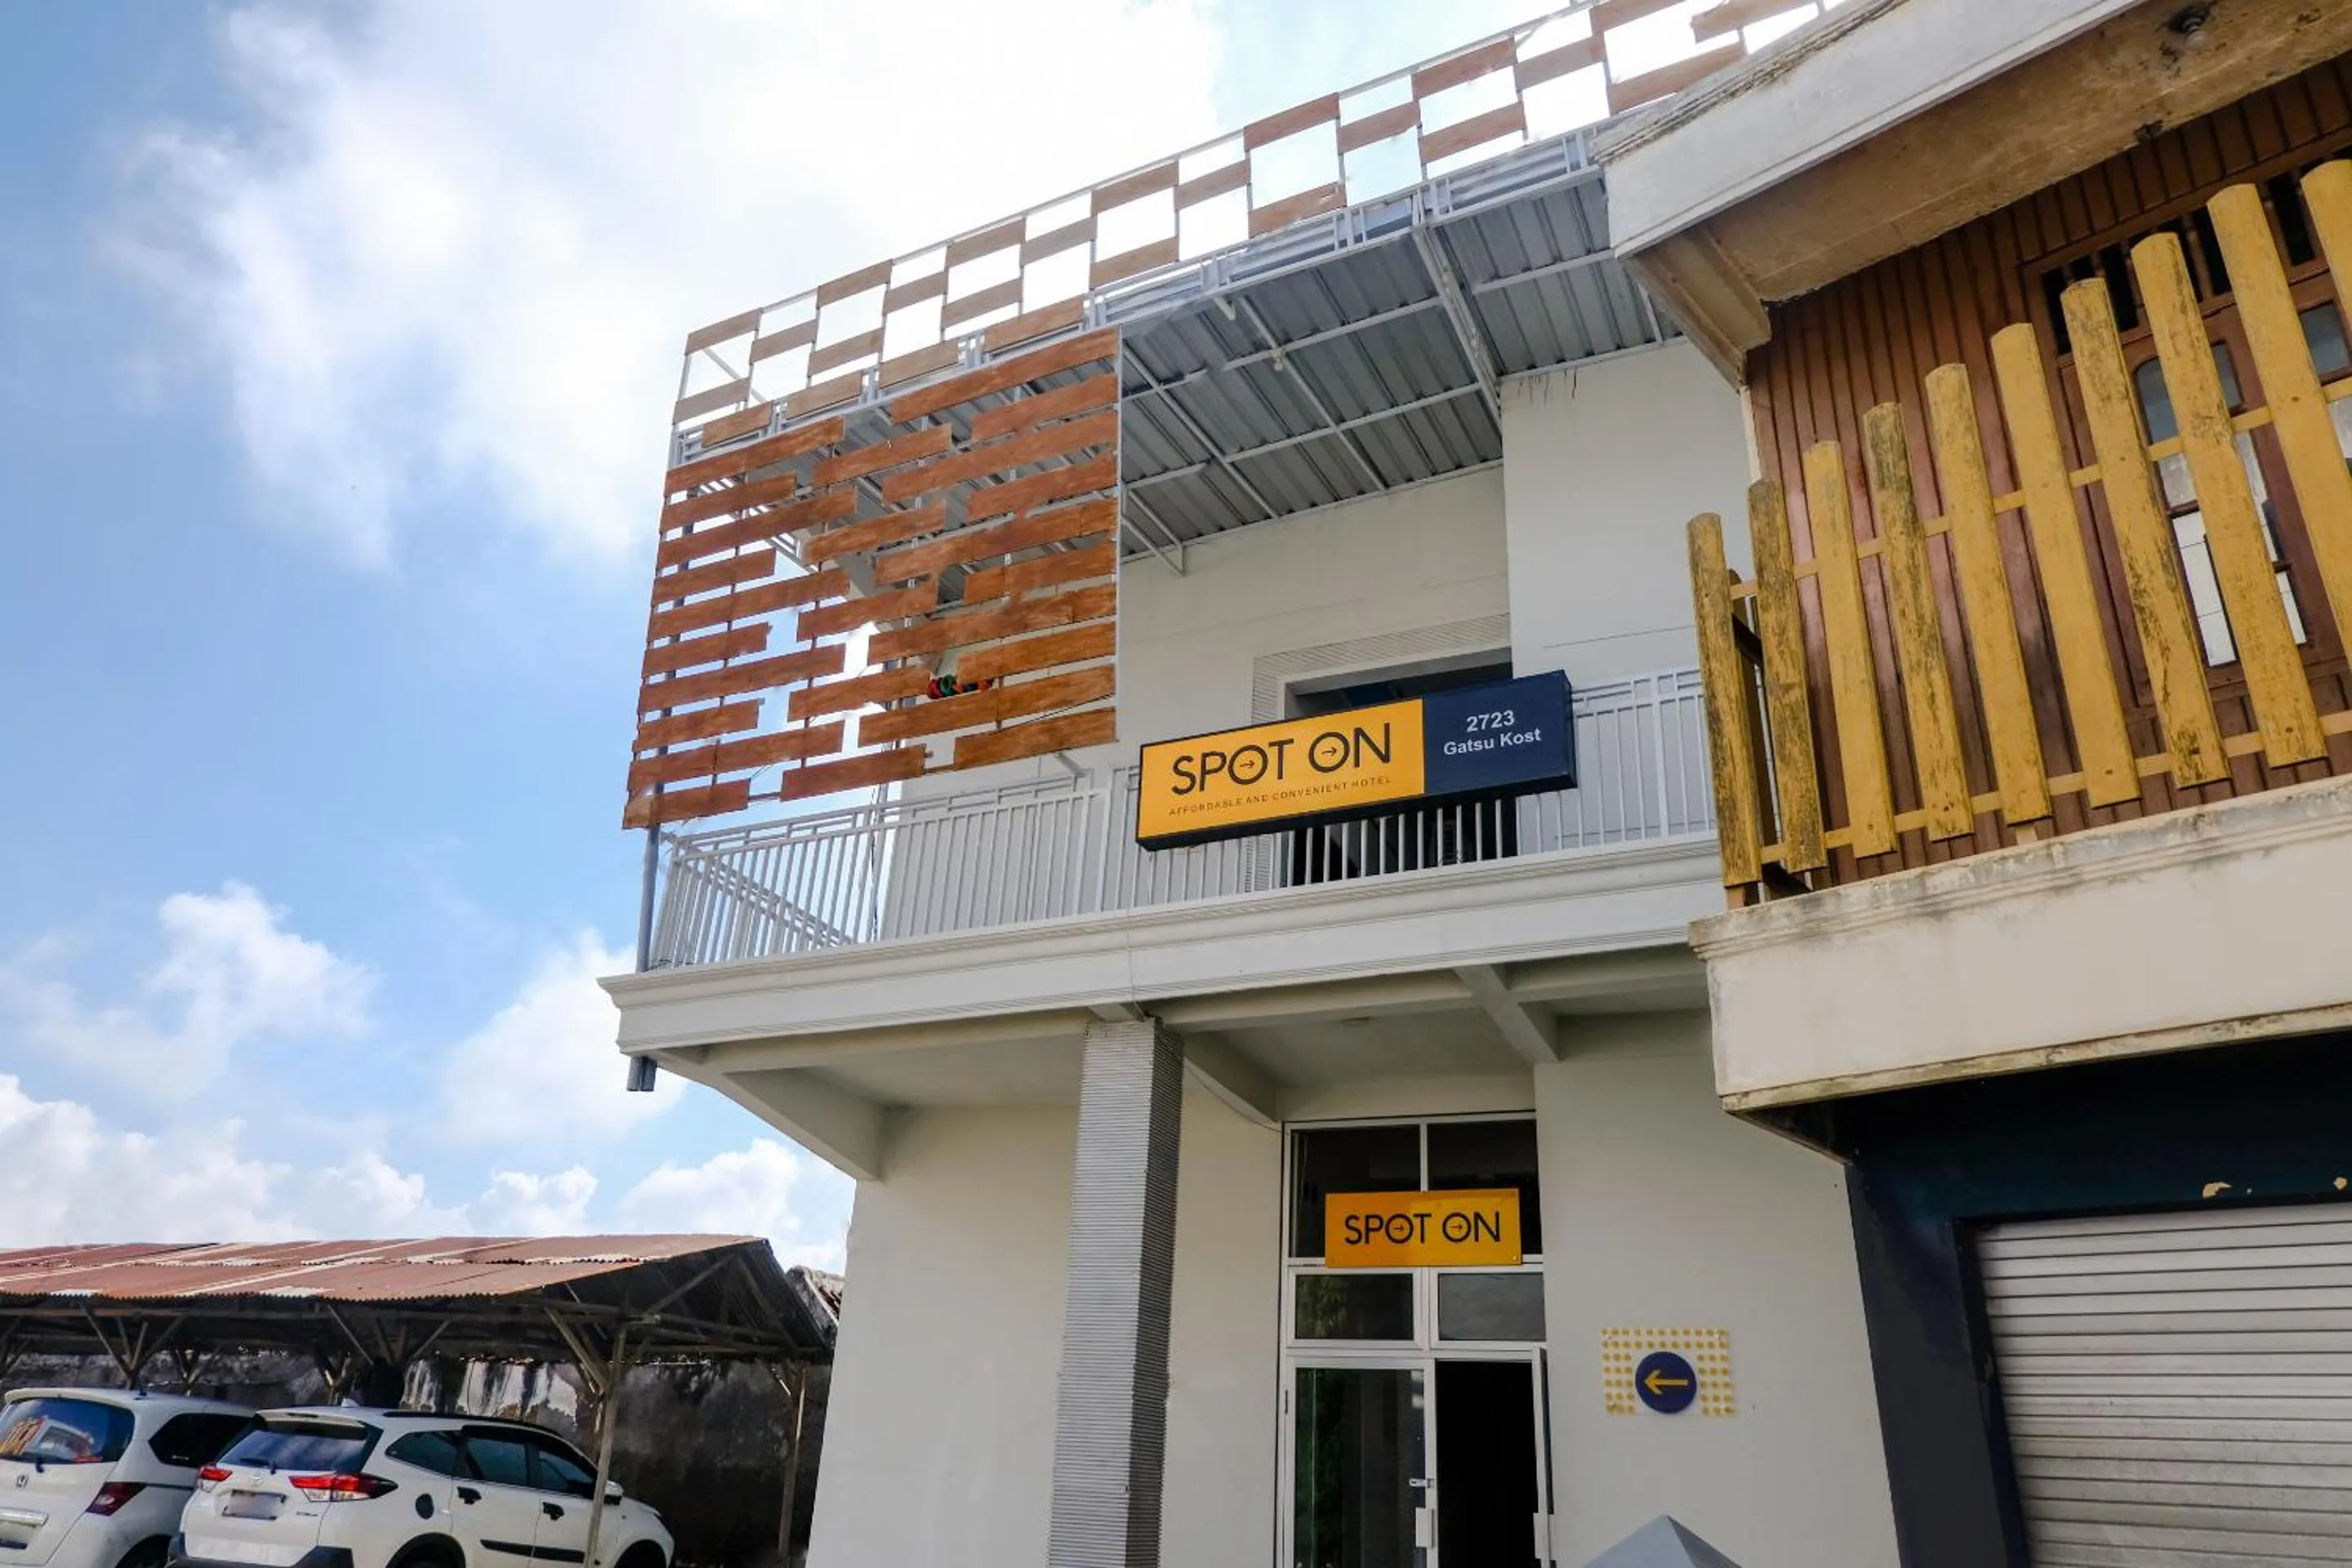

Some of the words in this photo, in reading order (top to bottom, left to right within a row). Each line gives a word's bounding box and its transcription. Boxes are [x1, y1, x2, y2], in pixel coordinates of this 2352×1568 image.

[1467, 710, 1515, 733] 2723
[1443, 738, 1494, 755] Gatsu
[1500, 728, 1541, 747] Kost
[1171, 738, 1294, 795] SPOT
[1308, 723, 1391, 773] ON
[1169, 797, 1242, 816] AFFORDABLE
[1246, 793, 1268, 804] AND
[1272, 782, 1348, 800] CONVENIENT
[1352, 775, 1391, 789] HOTEL
[1344, 1214, 1432, 1245] SPOT
[1442, 1211, 1501, 1243] ON
